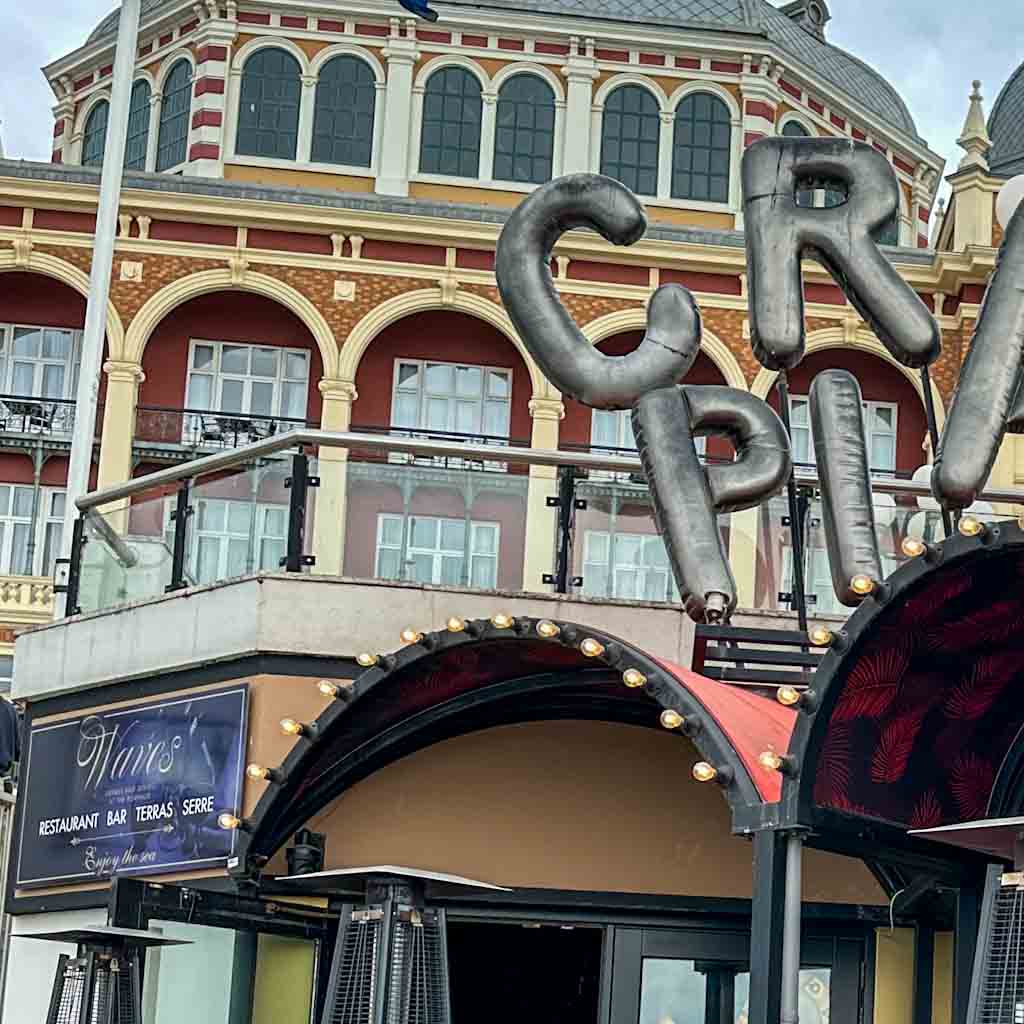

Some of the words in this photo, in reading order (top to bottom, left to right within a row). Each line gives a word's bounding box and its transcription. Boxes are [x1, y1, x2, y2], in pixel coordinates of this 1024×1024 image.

[38, 812, 100, 837] RESTAURANT
[106, 808, 127, 826] BAR
[135, 801, 174, 822] TERRAS
[182, 796, 215, 816] SERRE
[82, 845, 120, 878] Enjoy
[121, 844, 139, 865] the
[139, 850, 157, 864] sea
